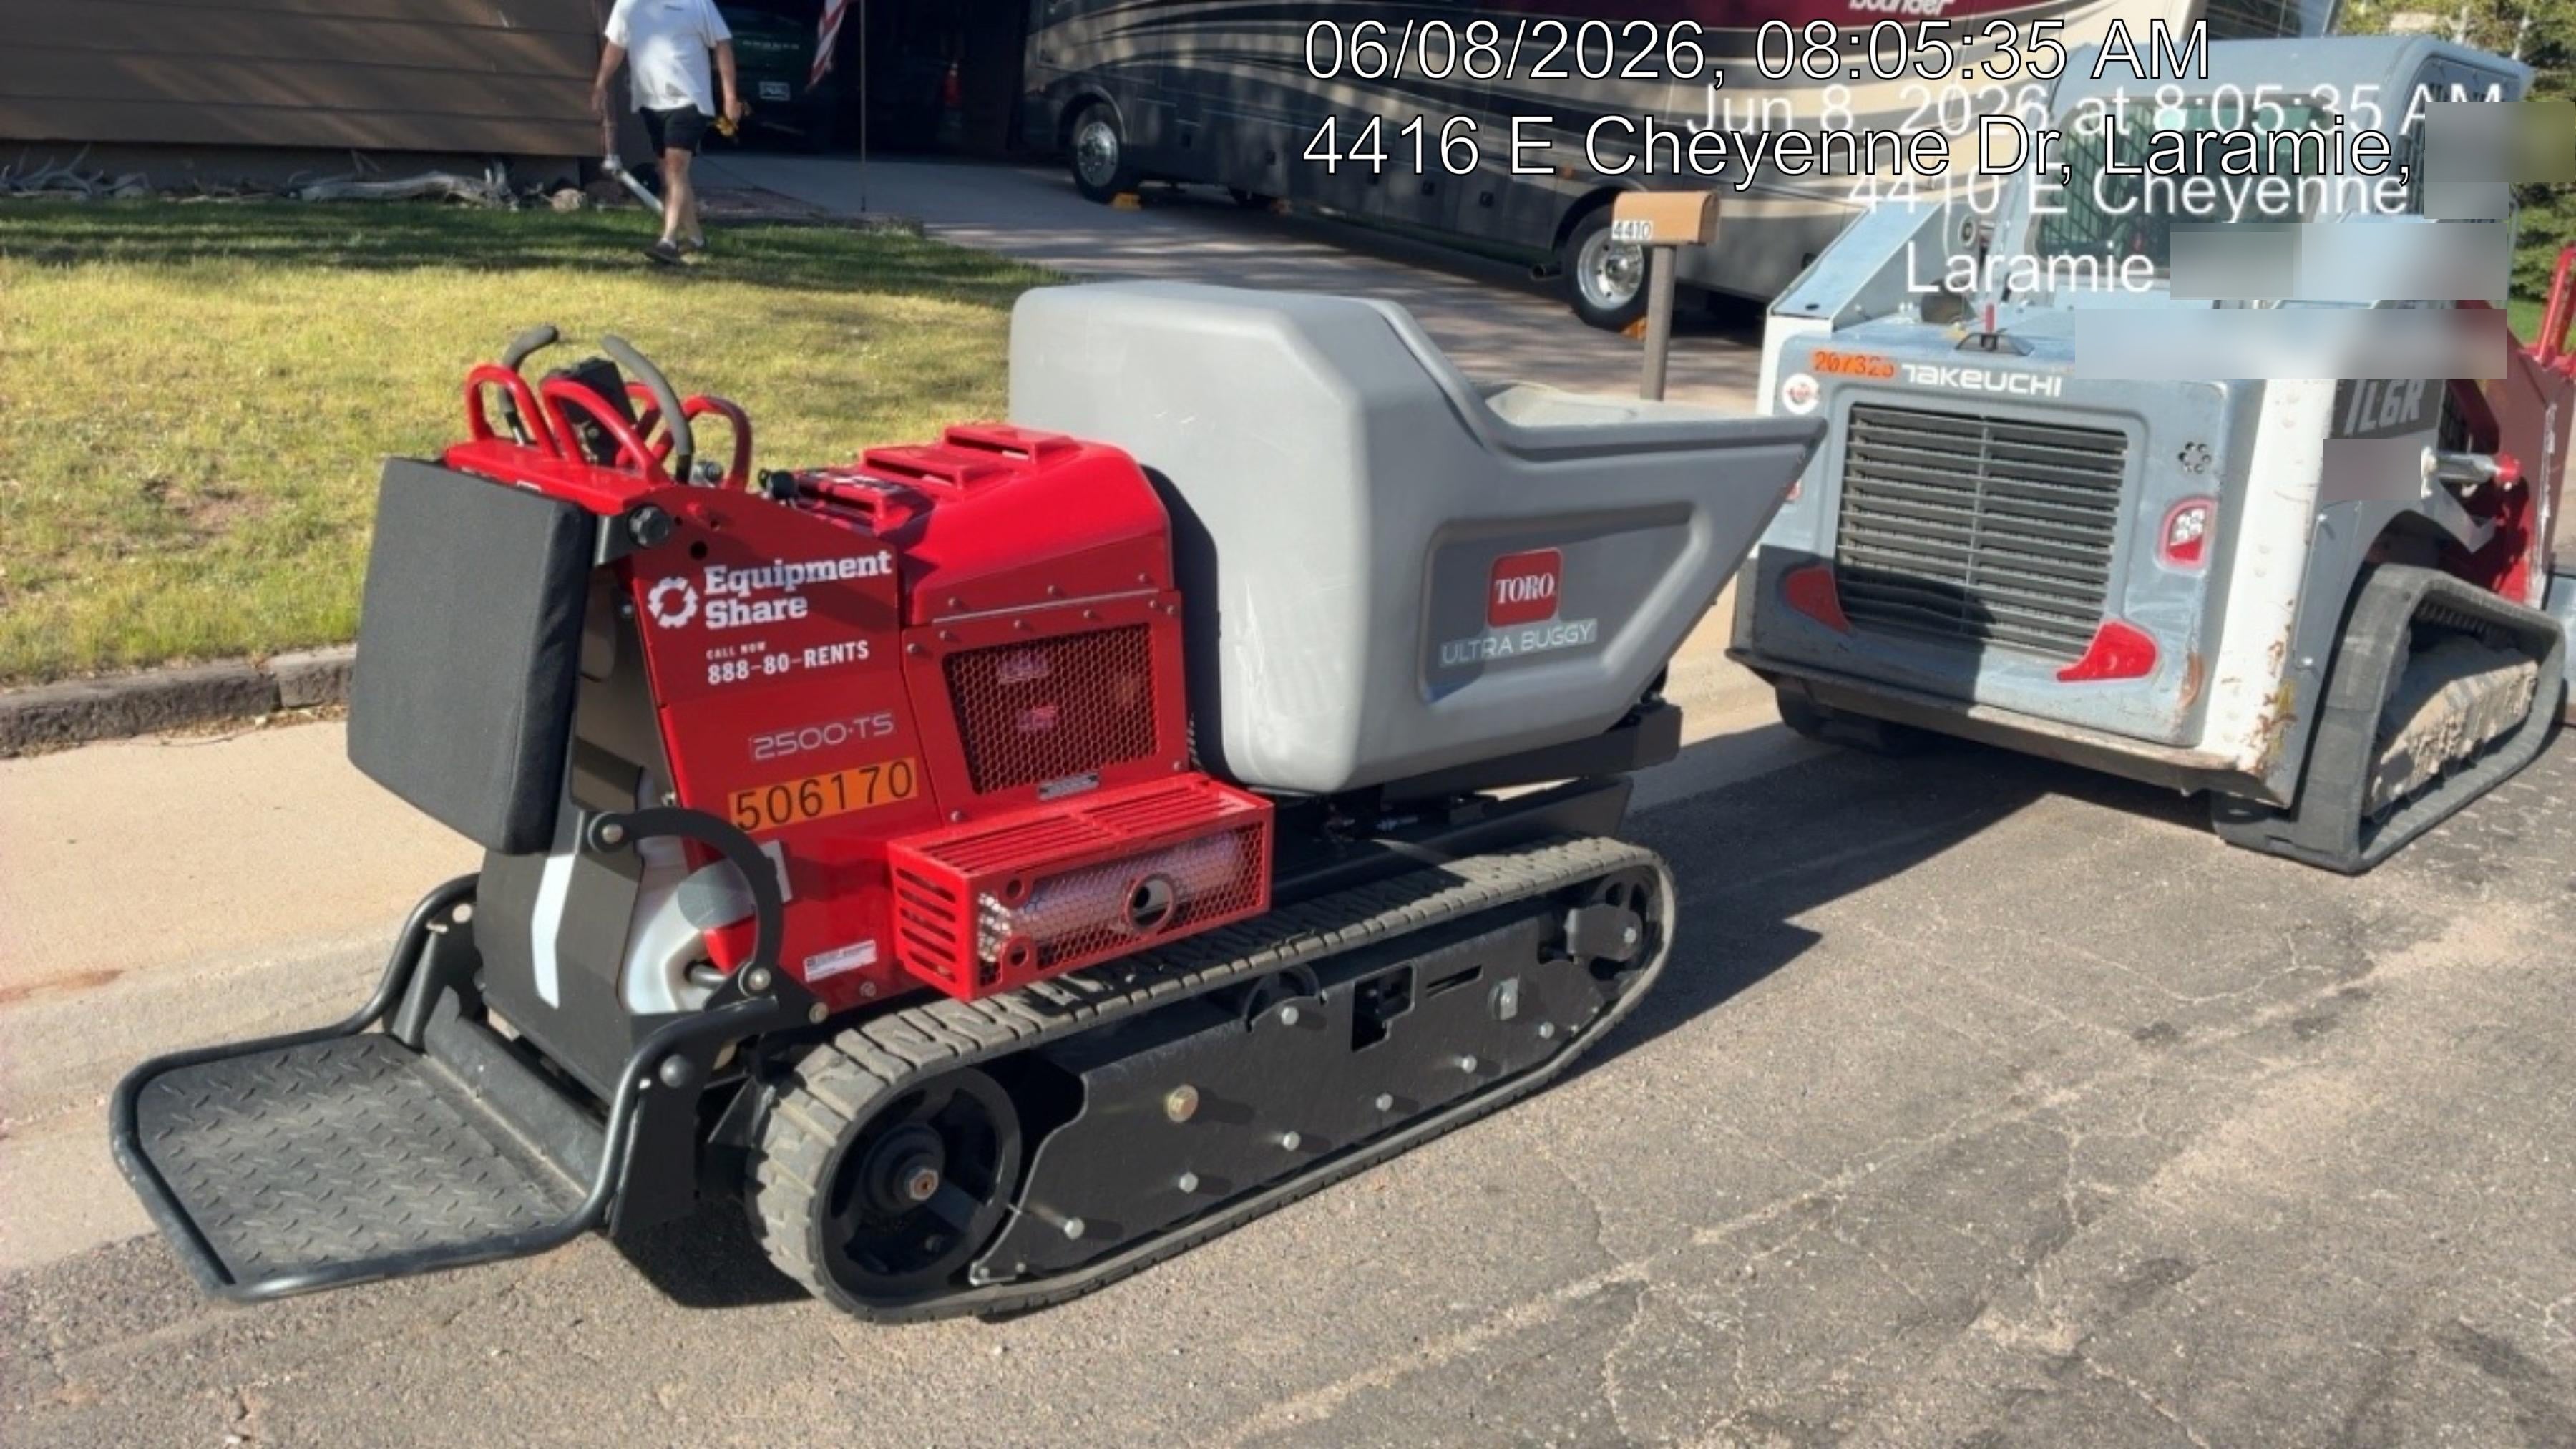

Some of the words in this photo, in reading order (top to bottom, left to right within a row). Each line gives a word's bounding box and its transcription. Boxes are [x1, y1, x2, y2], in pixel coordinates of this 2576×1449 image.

[1613, 221, 1654, 240] 4410
[704, 550, 892, 597] Equipment
[1496, 572, 1555, 604] TORO
[706, 597, 808, 630] Share
[706, 646, 735, 660] CALL
[741, 642, 766, 655] NOW
[1441, 635, 1512, 664] ULTRA
[1521, 623, 1592, 651] BUGGY
[708, 640, 869, 685] 888-80-RENTS
[736, 761, 912, 831] 506170
